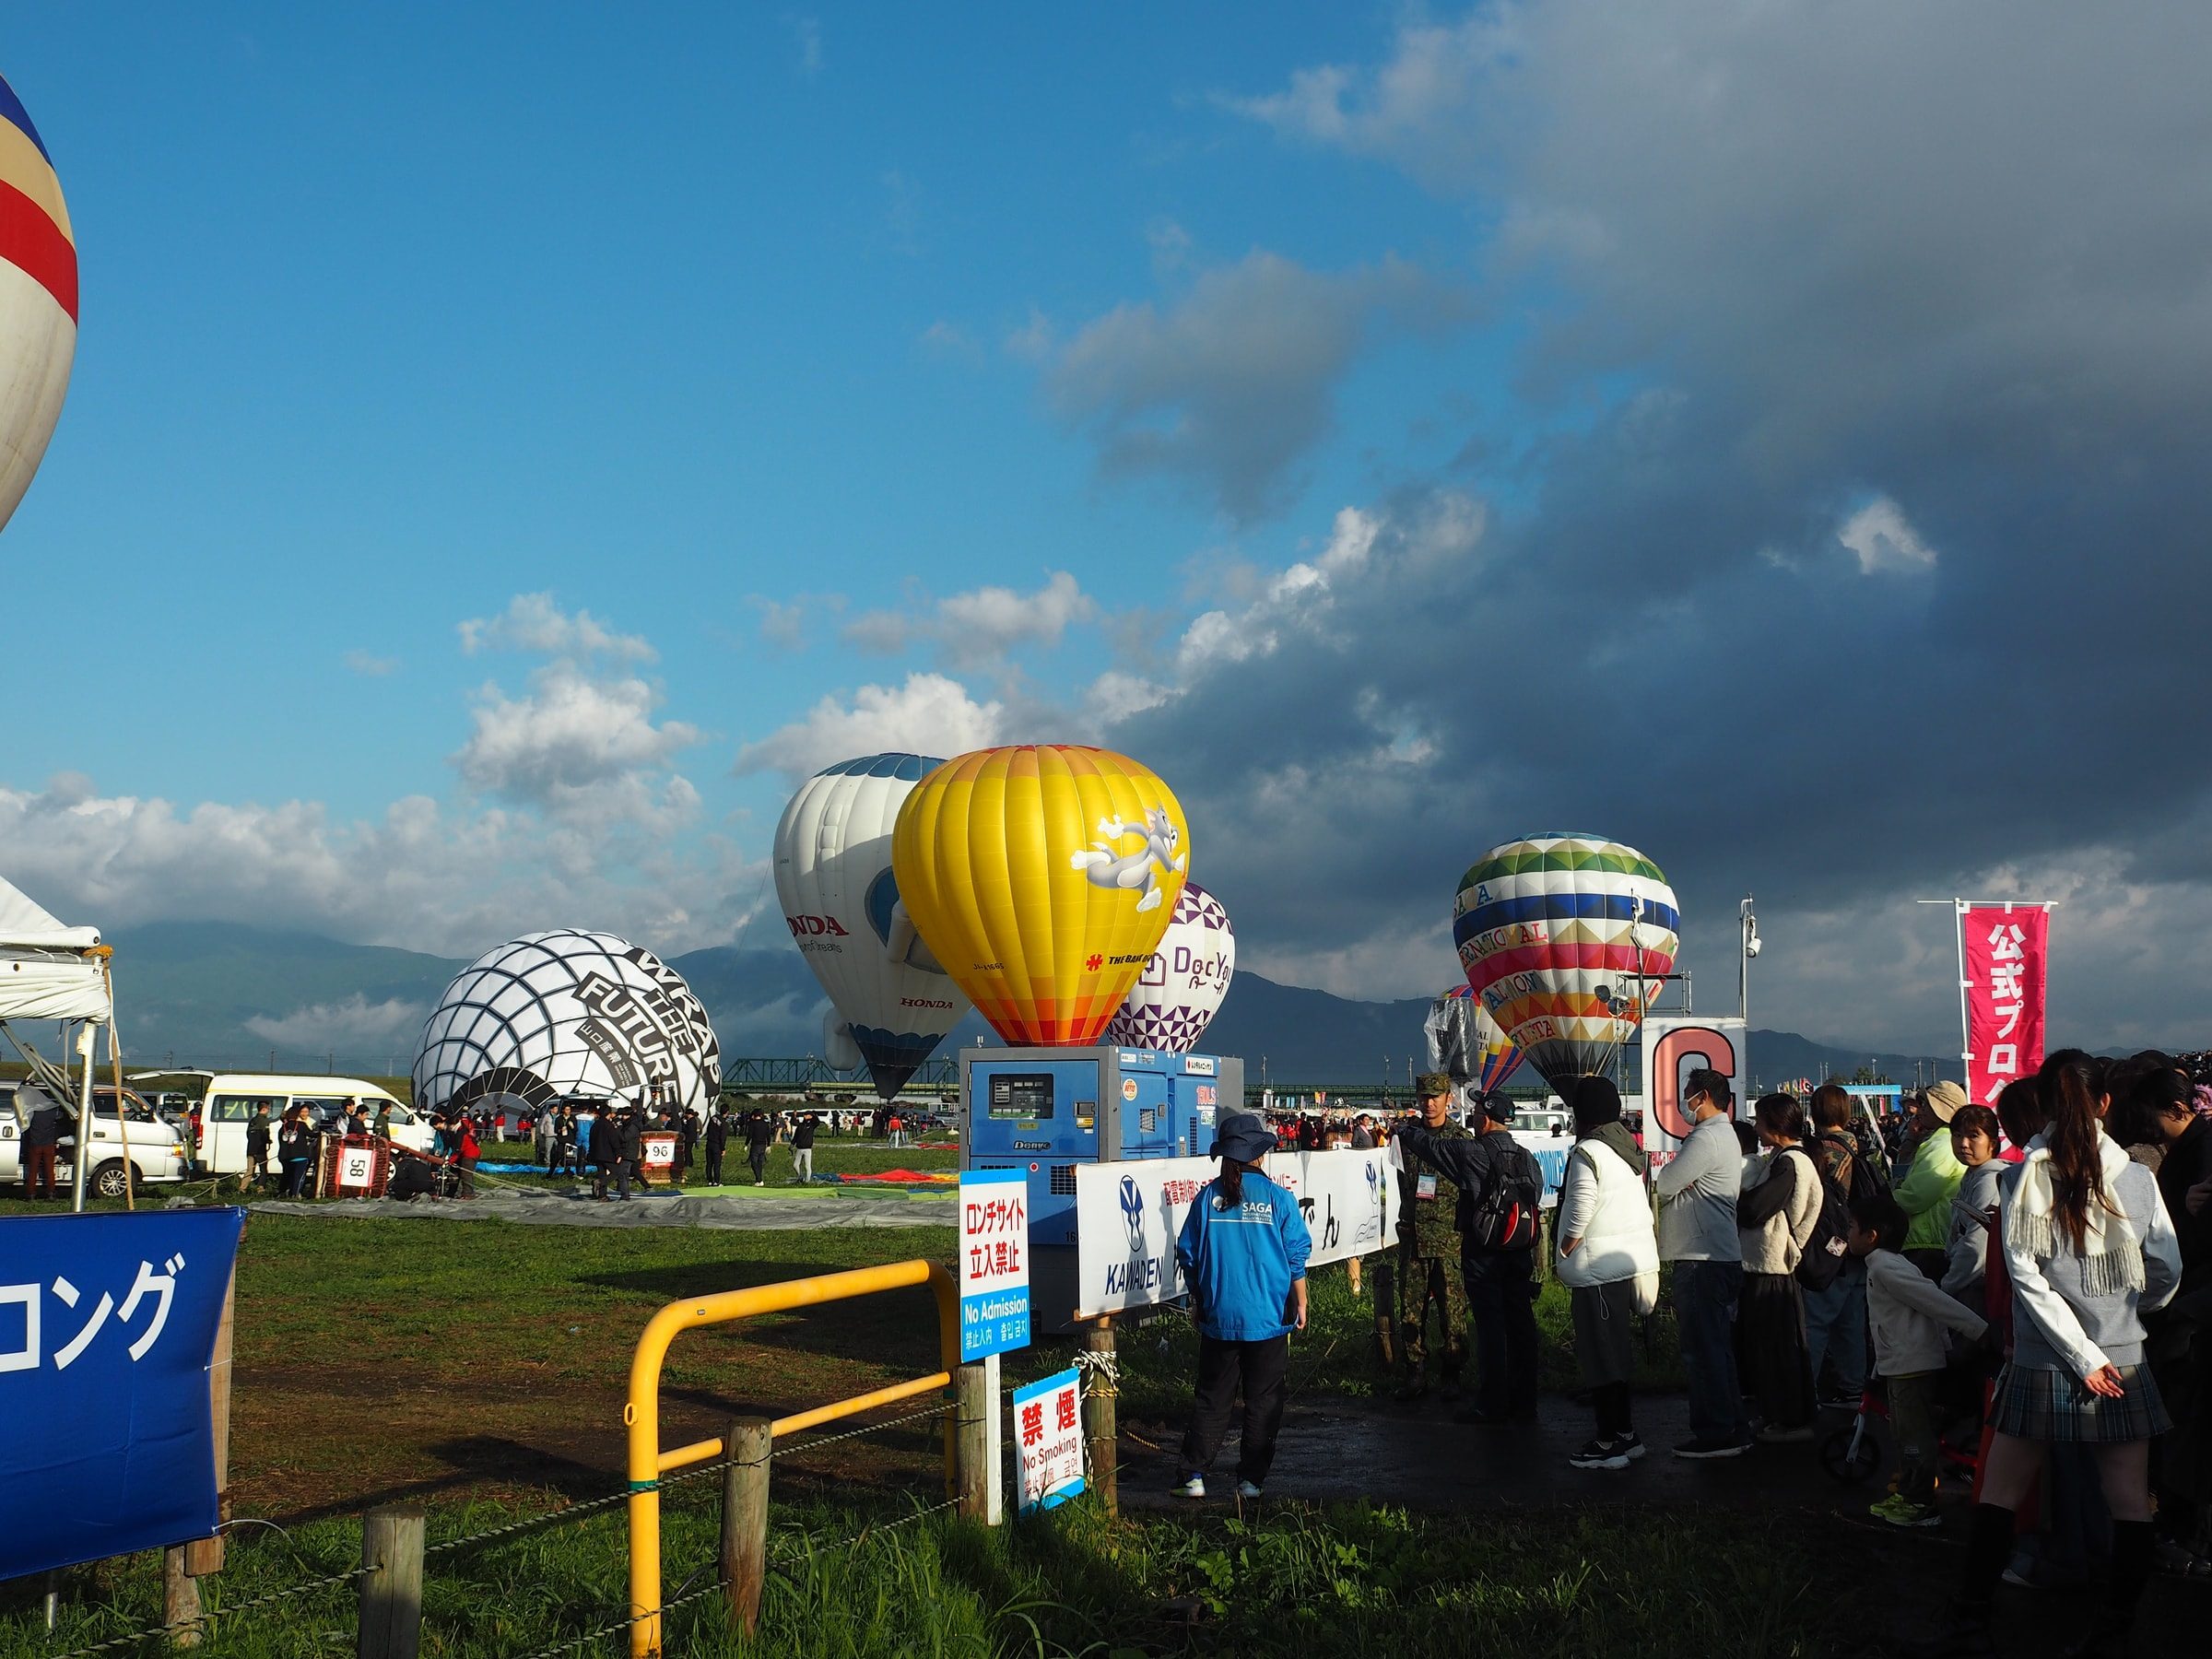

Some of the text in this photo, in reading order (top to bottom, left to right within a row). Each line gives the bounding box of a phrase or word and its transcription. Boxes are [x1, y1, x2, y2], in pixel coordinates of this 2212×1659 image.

[637, 952, 720, 1084] WRAP
[900, 997, 954, 1009] HONDA
[649, 991, 692, 1050] THE
[579, 976, 678, 1106] FUTURE
[653, 1146, 668, 1158] 96
[1014, 1140, 1052, 1152] Denyo
[349, 1159, 366, 1177] 58
[967, 1197, 1024, 1235] ロンチサイト
[1242, 1202, 1273, 1214] SAGA
[971, 1240, 1020, 1279] 立入禁止
[1105, 1255, 1164, 1296] KAWADEN
[965, 1295, 1028, 1325] No Admission
[966, 1326, 993, 1350] 禁止入内
[1023, 1436, 1077, 1473] No Smoking
